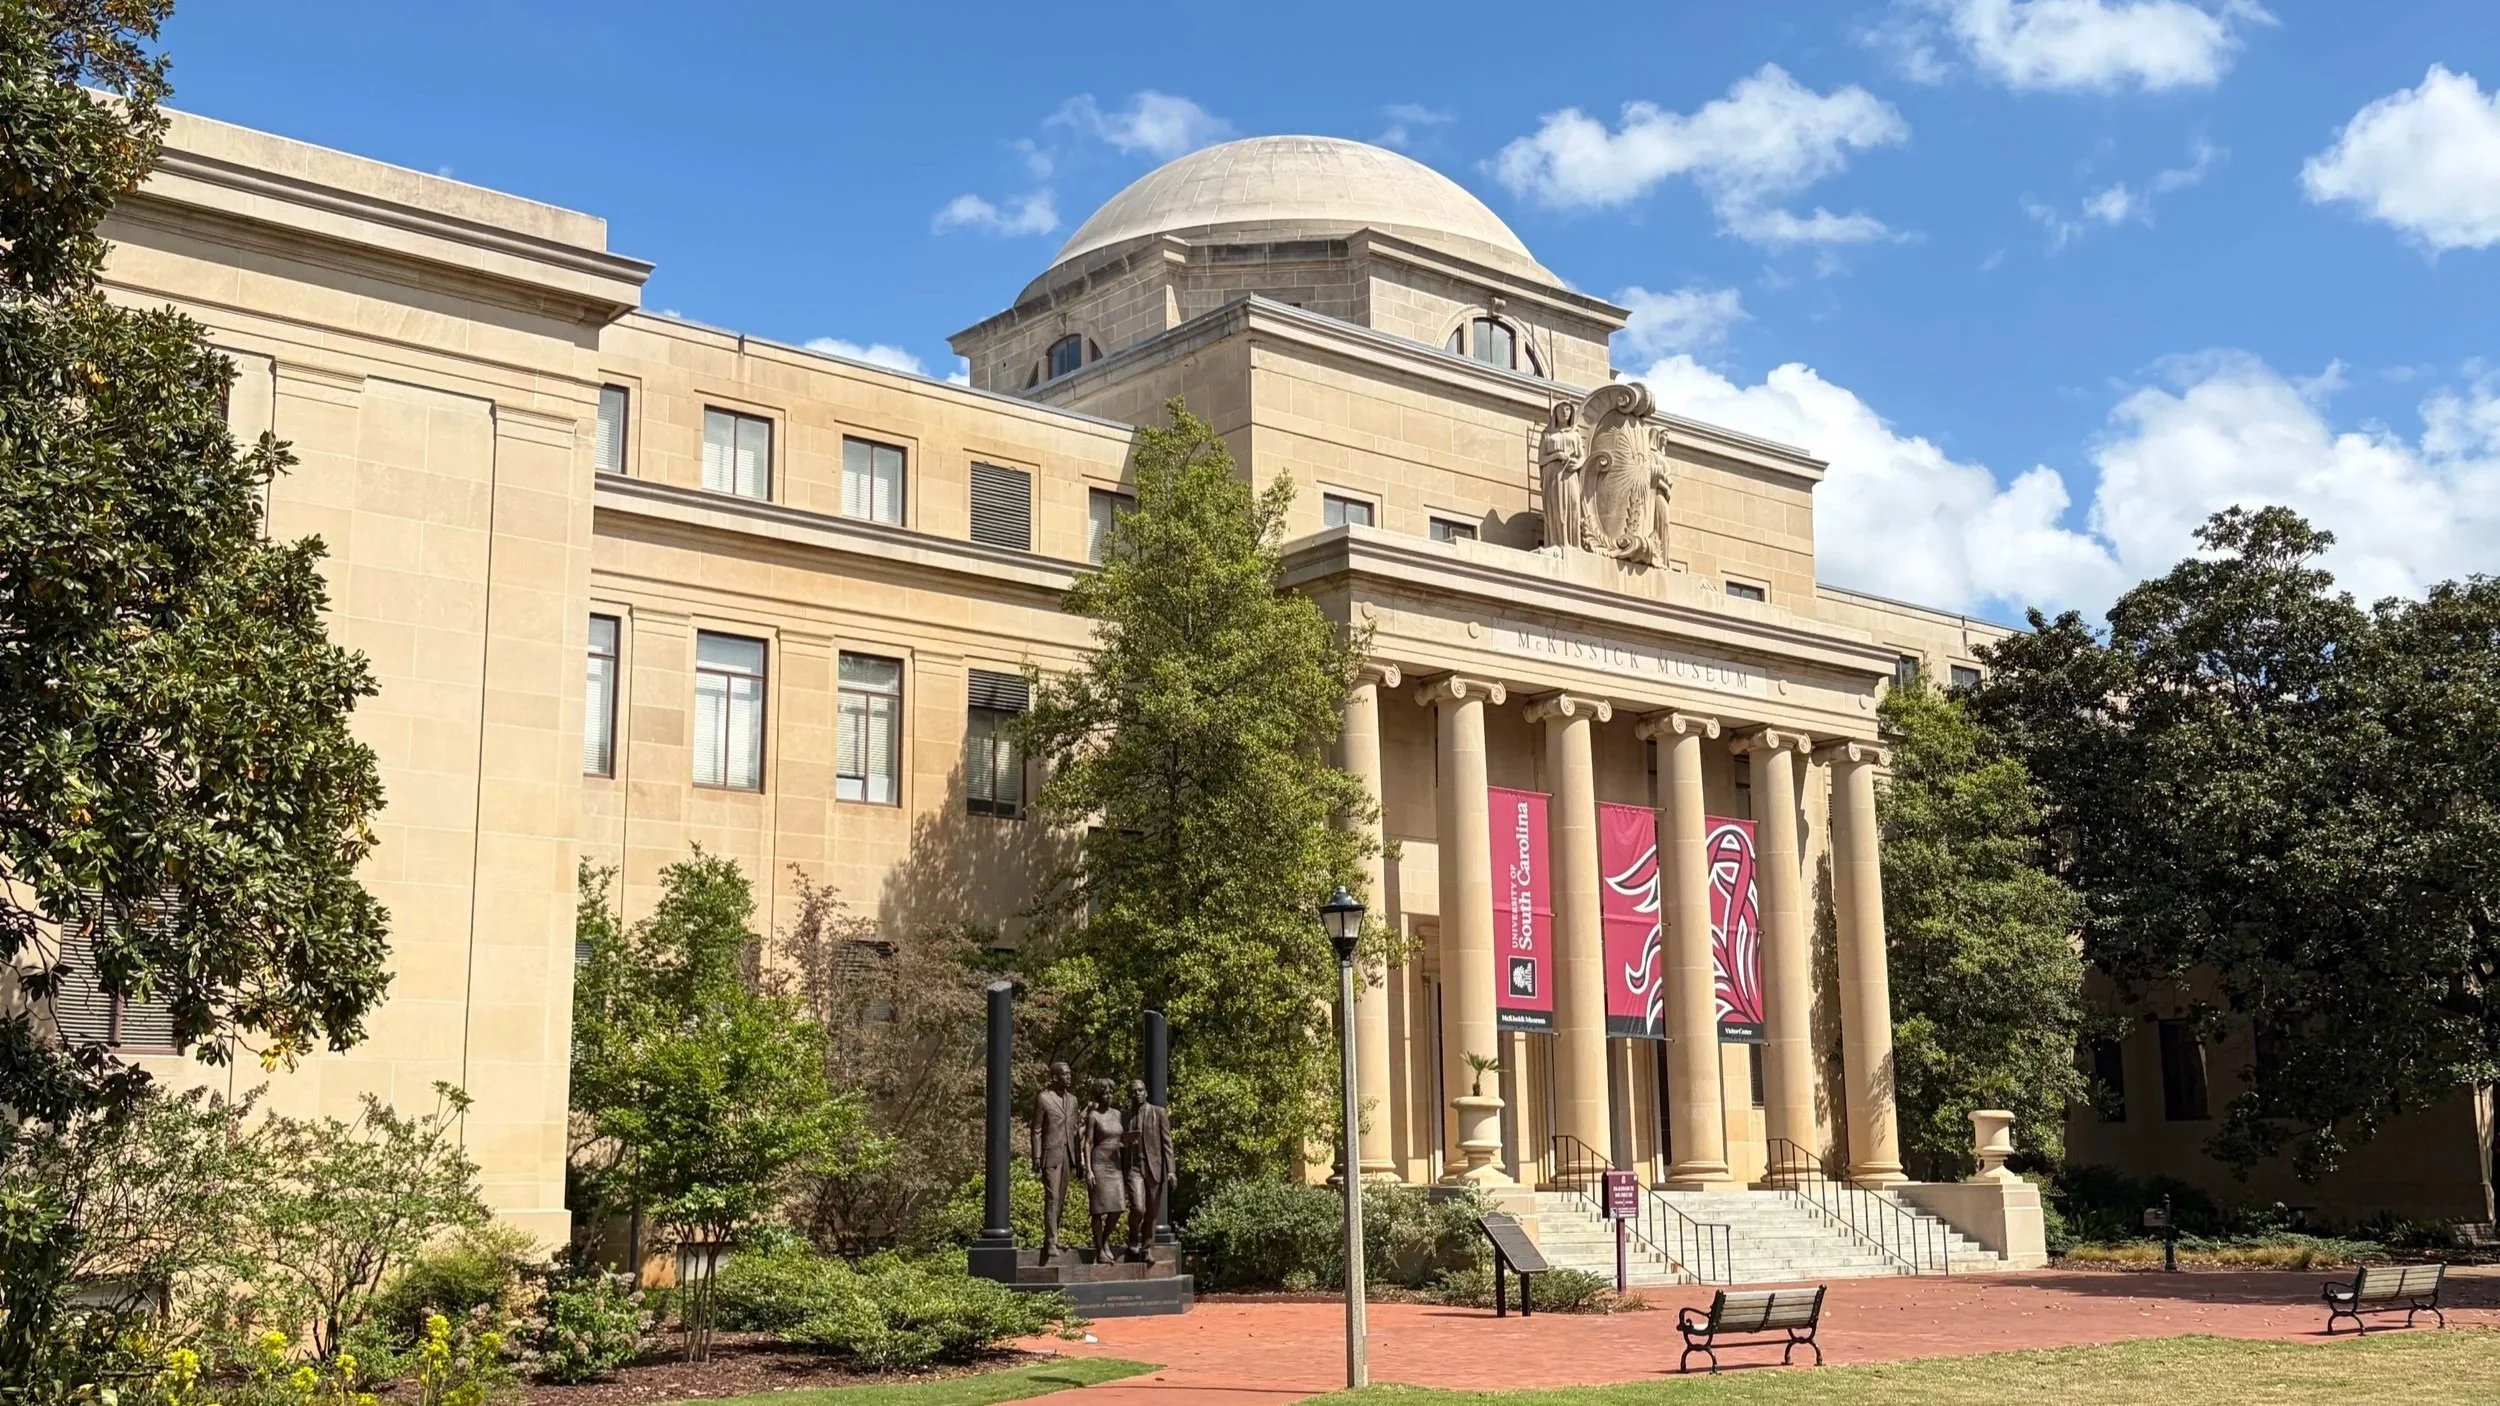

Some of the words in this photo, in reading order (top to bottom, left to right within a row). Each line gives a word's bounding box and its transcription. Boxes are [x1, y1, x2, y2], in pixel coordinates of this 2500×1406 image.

[1517, 629, 1640, 669] McKISSICK
[1657, 655, 1748, 689] MUSEUM
[1509, 863, 1517, 880] OF
[1516, 802, 1531, 887] Carolina
[1510, 882, 1519, 949] UNIVERSITY
[1518, 890, 1533, 951] South
